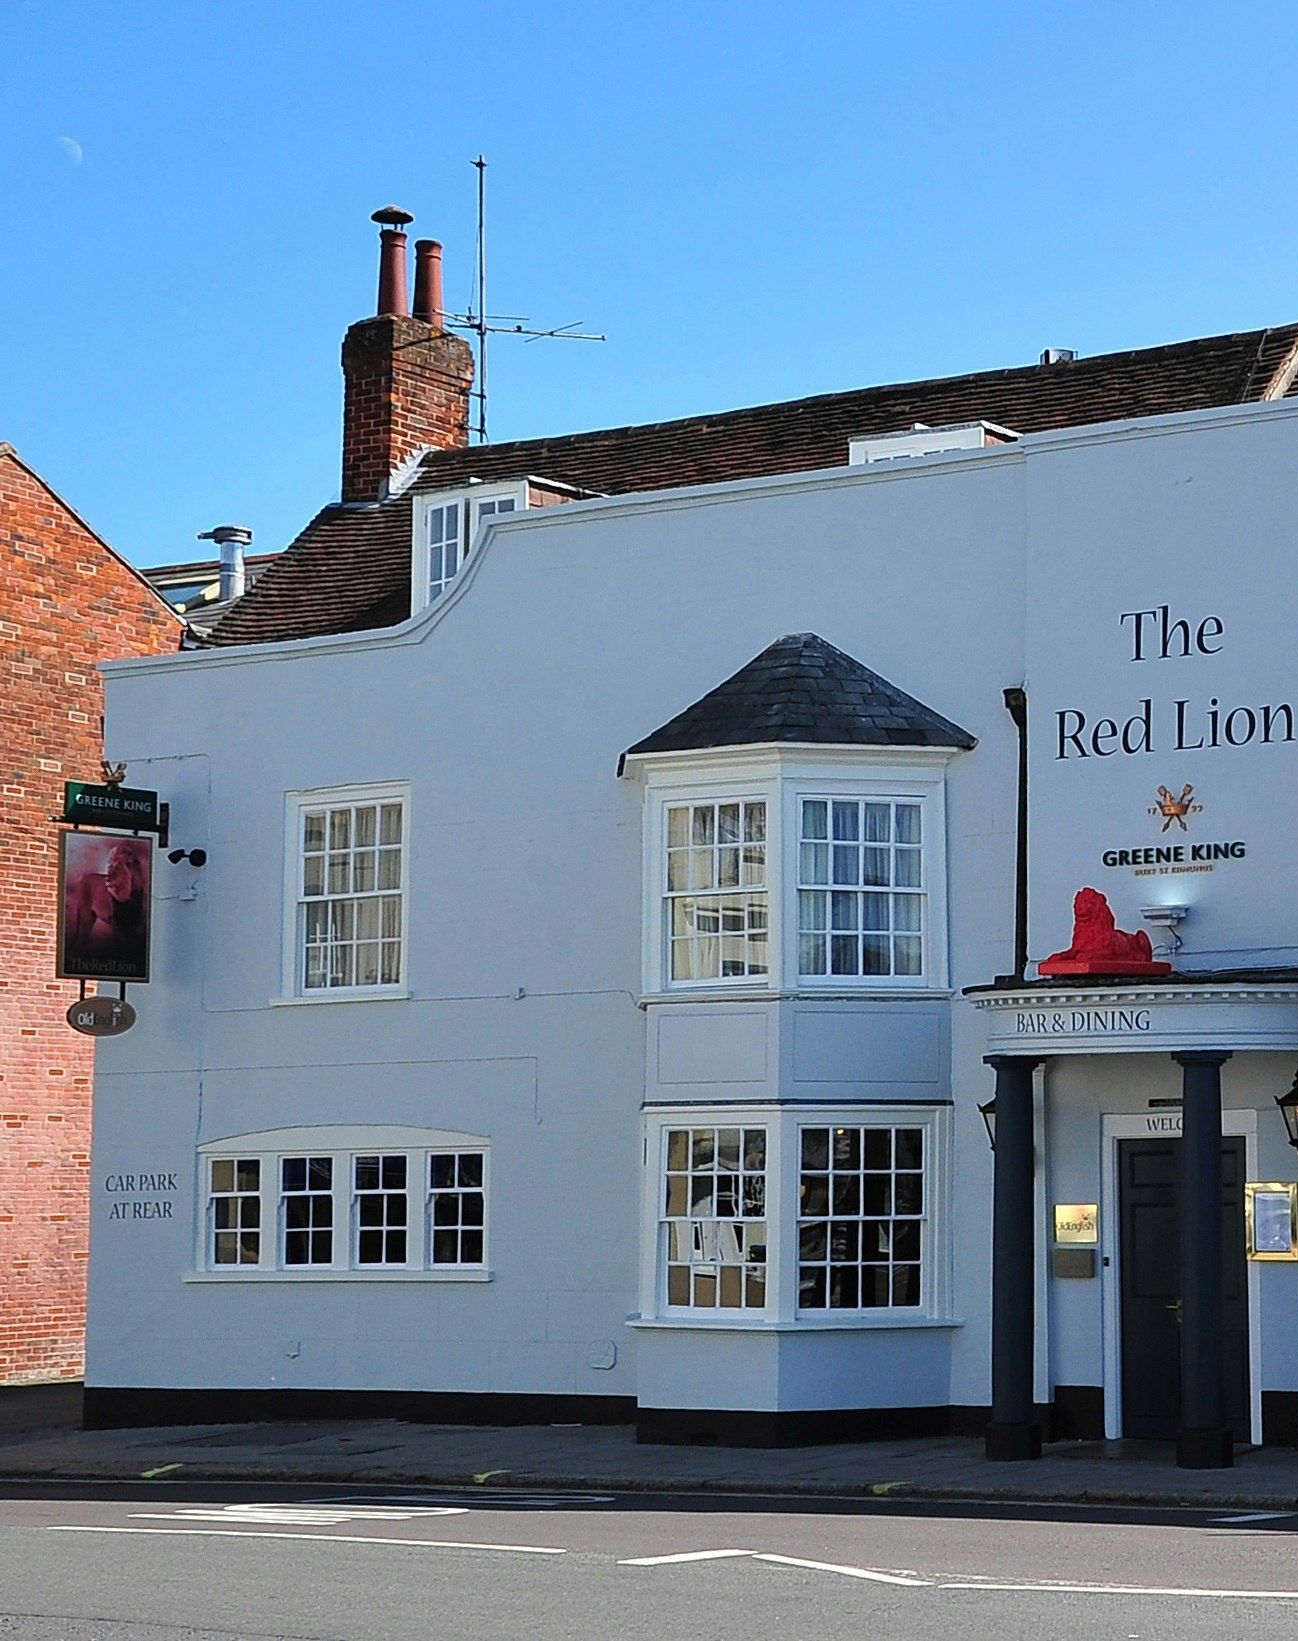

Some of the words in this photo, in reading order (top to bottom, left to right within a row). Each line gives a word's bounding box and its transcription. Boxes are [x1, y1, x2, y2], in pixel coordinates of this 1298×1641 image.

[1120, 605, 1224, 662] The
[1054, 698, 1155, 760] Red
[1173, 697, 1296, 751] Lion
[76, 793, 121, 810] GREENE
[123, 800, 152, 812] KING
[1102, 846, 1185, 867] GREENE
[1191, 841, 1246, 861] KING
[1016, 1012, 1048, 1033] BAR
[1051, 1012, 1066, 1032] &
[1071, 1009, 1151, 1031] DINING
[1146, 1117, 1183, 1131] WELC
[105, 1174, 135, 1192] CAR
[139, 1173, 178, 1191] PARK
[109, 1202, 129, 1219] AT
[132, 1201, 173, 1219] REAR
